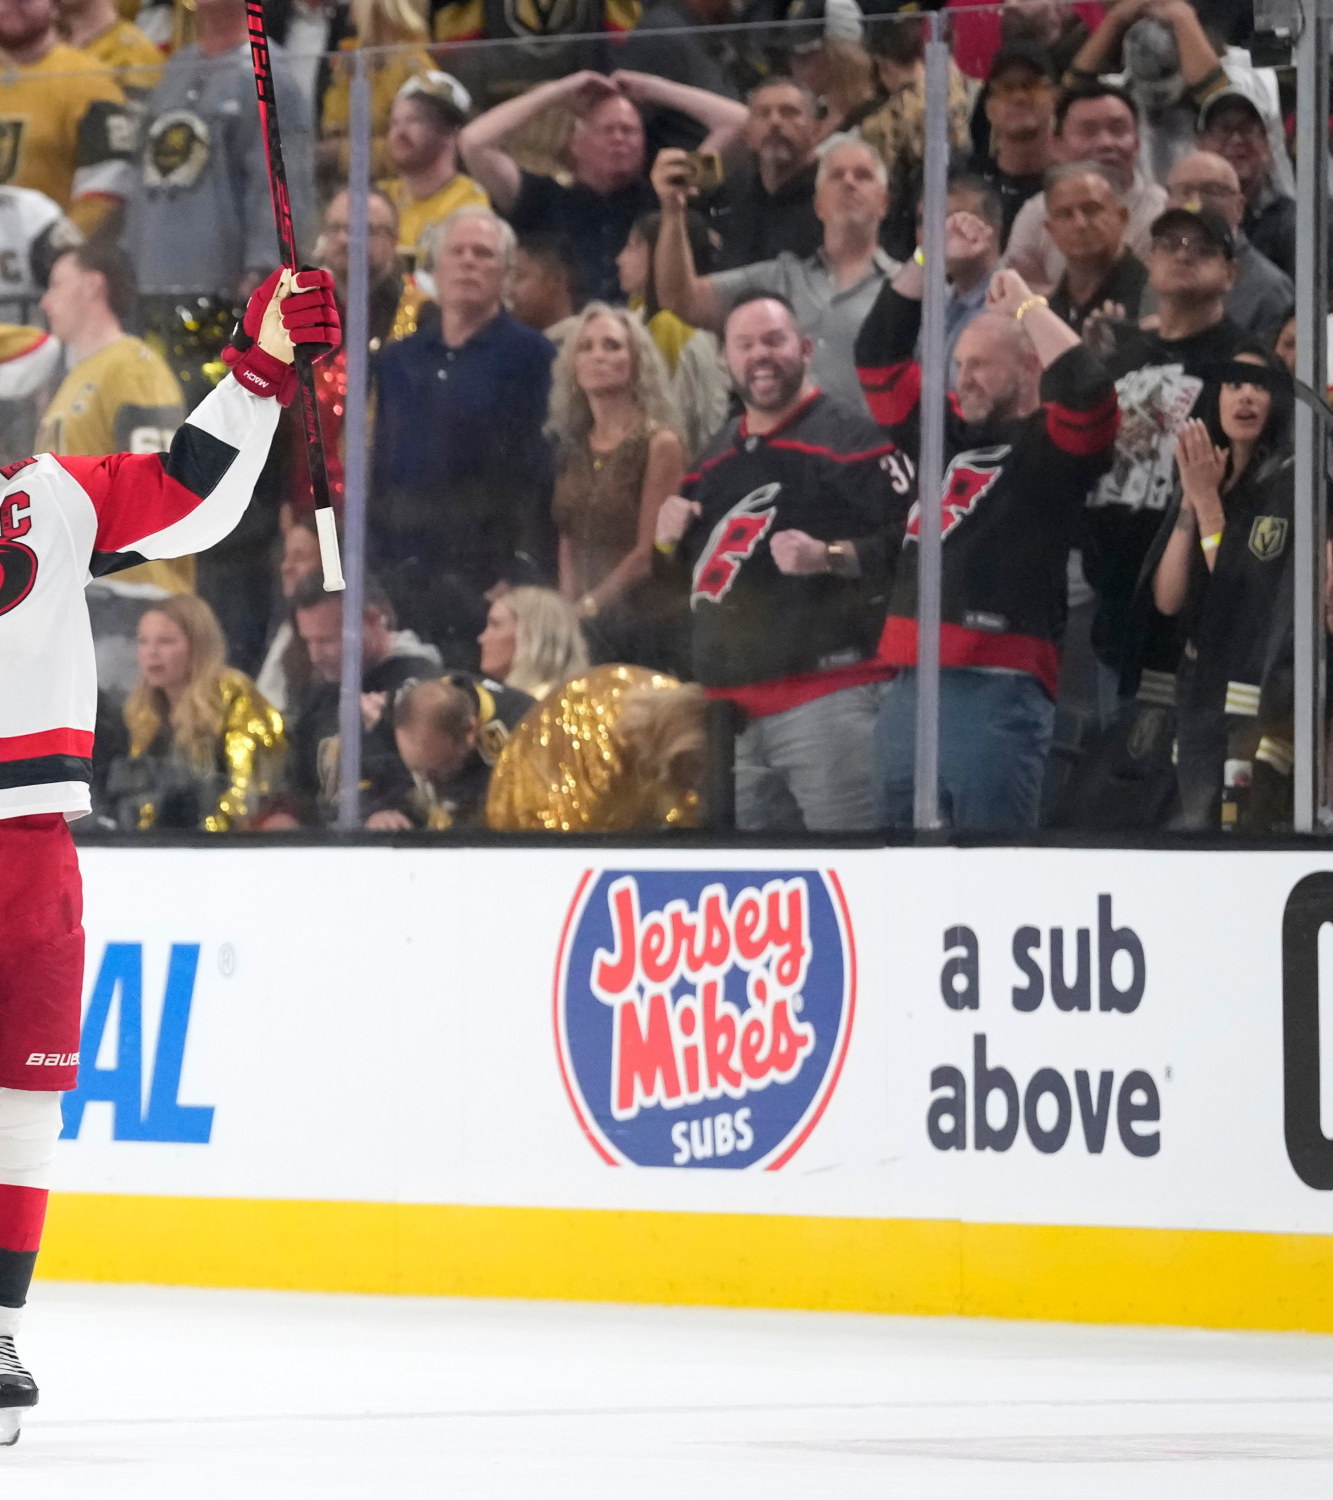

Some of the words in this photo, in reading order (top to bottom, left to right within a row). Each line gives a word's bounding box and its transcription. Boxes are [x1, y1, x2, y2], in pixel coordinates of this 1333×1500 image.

[243, 369, 269, 389] MACH
[596, 884, 807, 996] Jersey
[939, 924, 980, 1011] a
[1011, 893, 1147, 1014] sub
[616, 978, 810, 1112] Mike's
[926, 1032, 1162, 1158] above
[670, 1107, 755, 1165] SUBS
